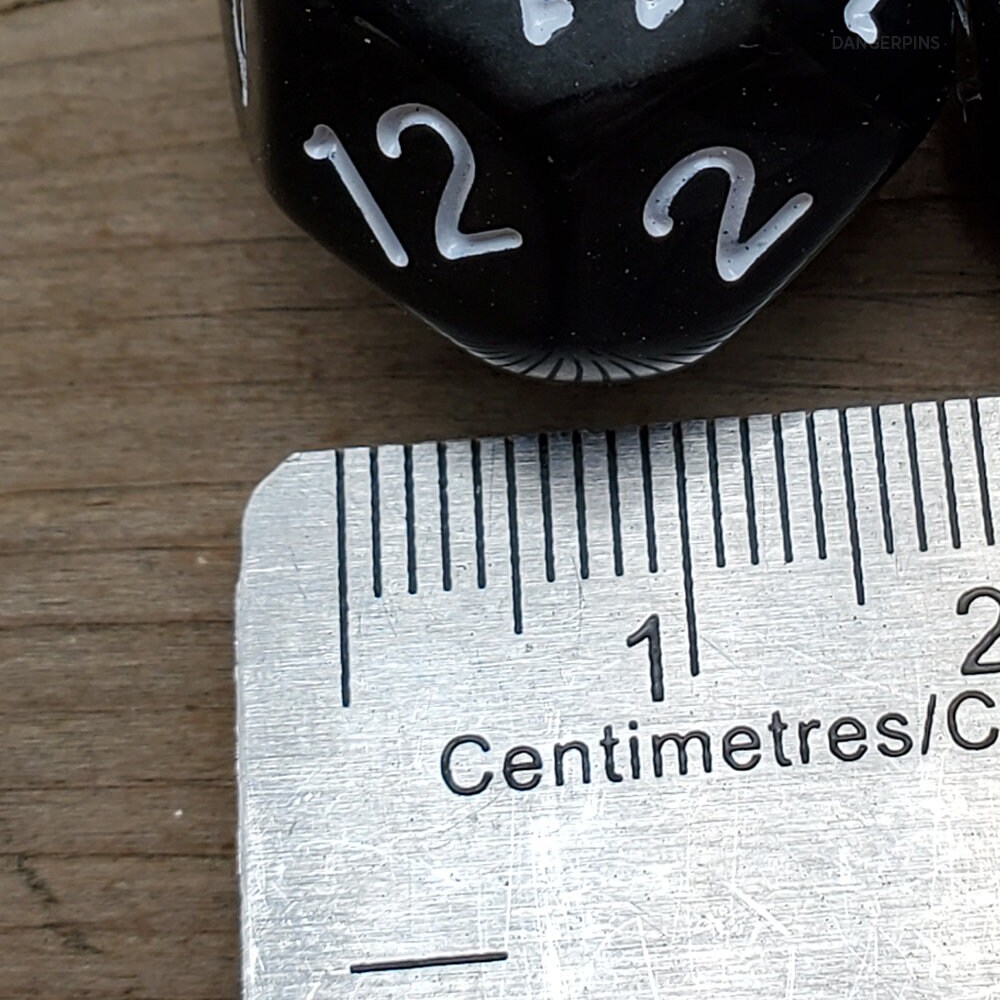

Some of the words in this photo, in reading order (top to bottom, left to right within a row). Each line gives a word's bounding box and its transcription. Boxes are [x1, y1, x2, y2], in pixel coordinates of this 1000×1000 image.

[304, 104, 522, 267] 12
[643, 147, 812, 281] 2
[627, 616, 663, 701] 1
